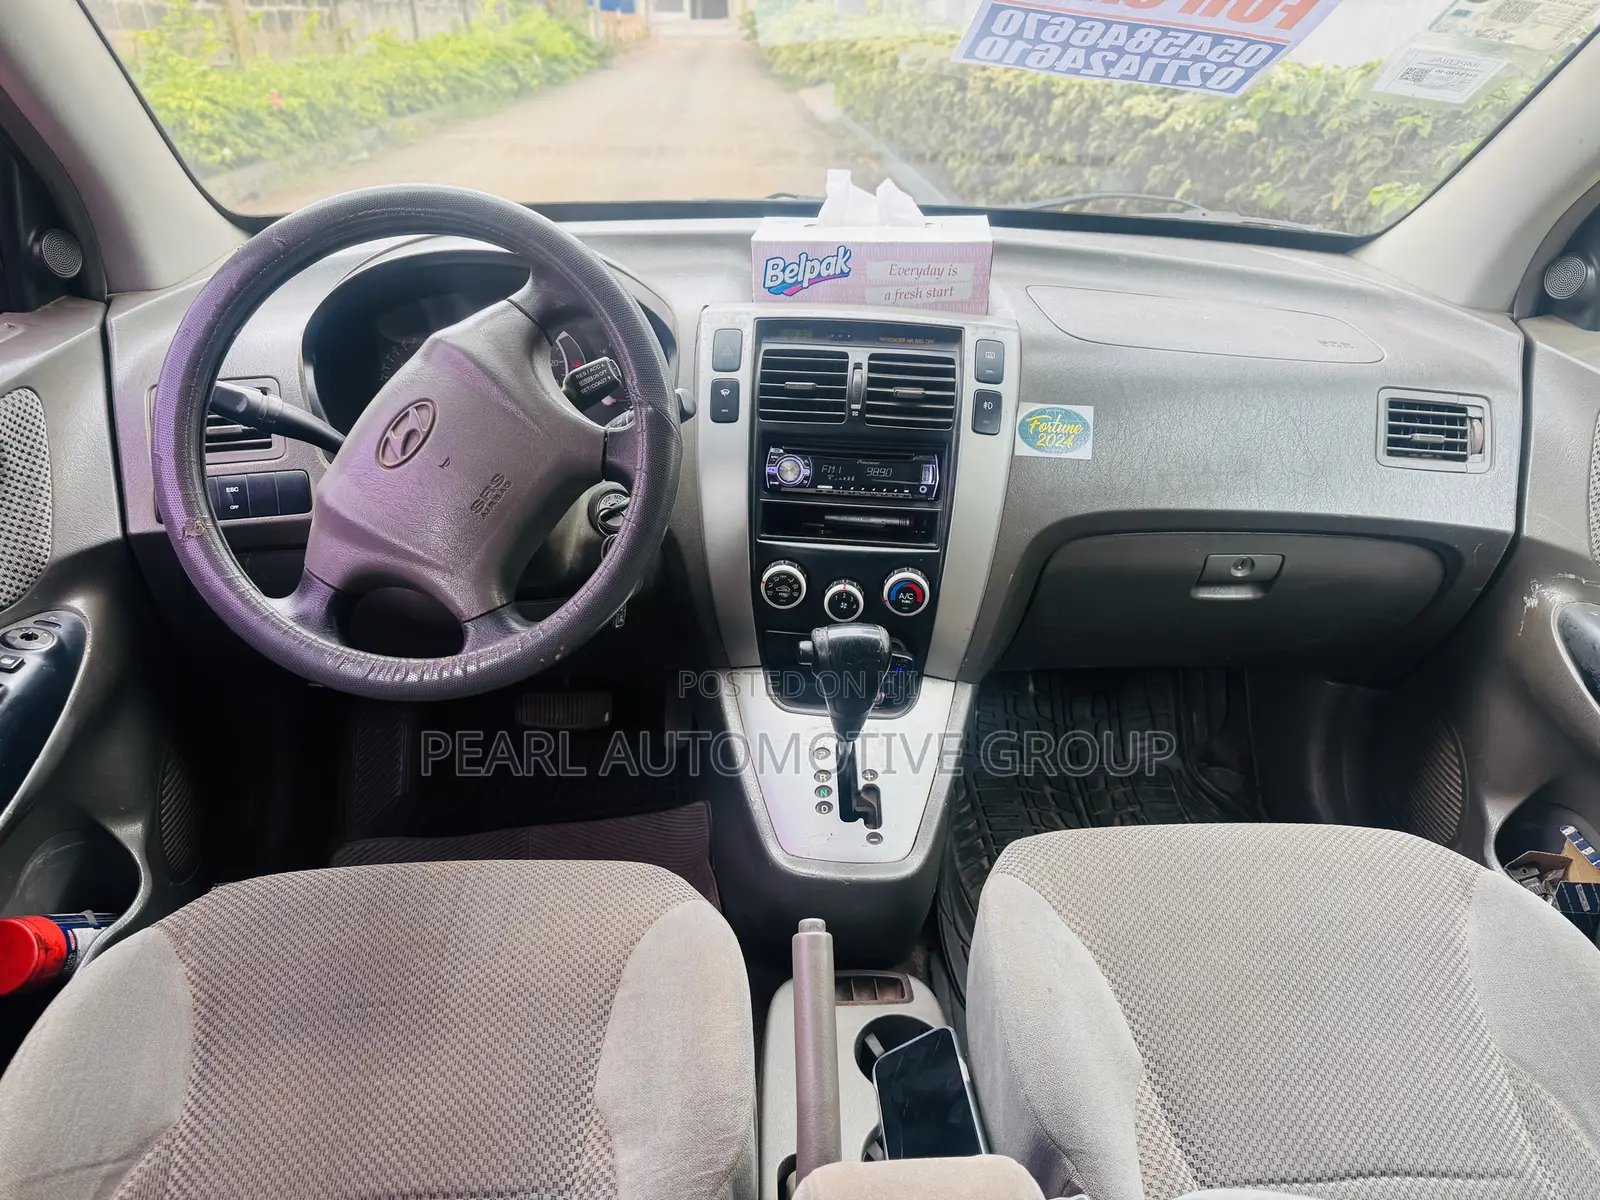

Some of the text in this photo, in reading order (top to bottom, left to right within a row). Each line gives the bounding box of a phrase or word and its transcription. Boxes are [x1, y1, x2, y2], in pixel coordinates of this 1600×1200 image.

[763, 245, 852, 289] Belpak
[889, 263, 959, 280] Everyday is
[884, 287, 955, 303] a fresh start
[1026, 413, 1084, 434] Fortune
[1036, 432, 1075, 448] 2024
[898, 592, 914, 600] A/C
[819, 774, 827, 782] R
[820, 789, 828, 797] N
[821, 805, 829, 813] D
